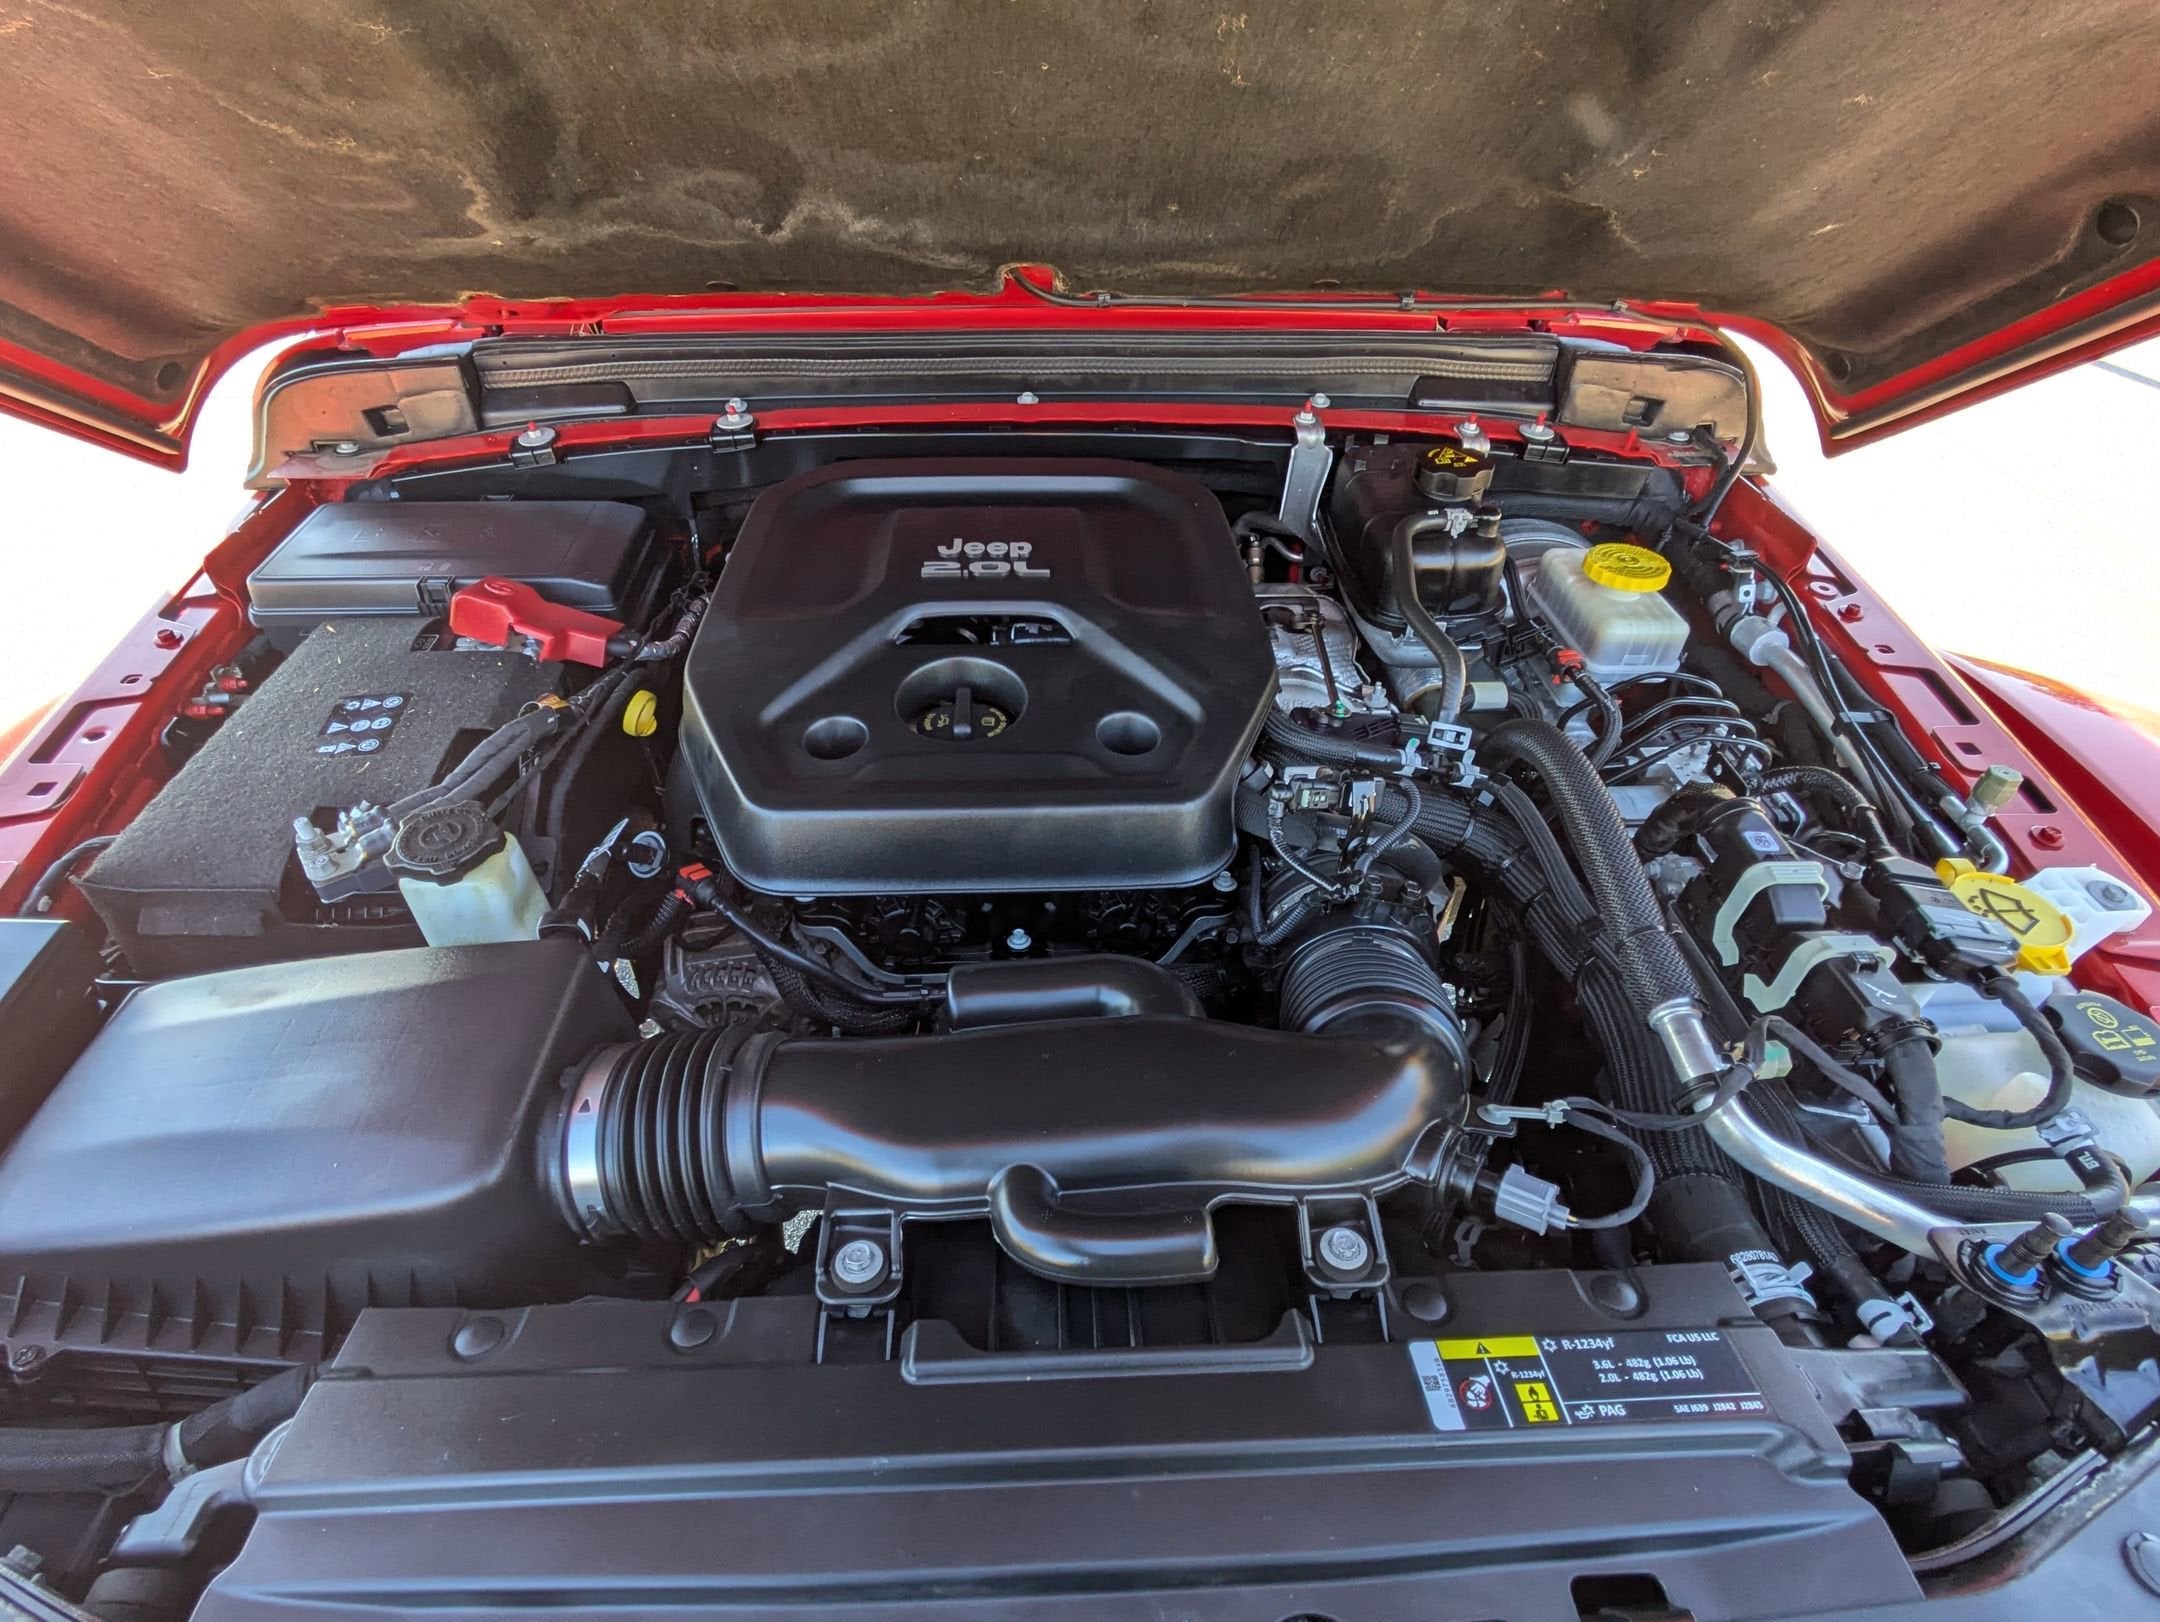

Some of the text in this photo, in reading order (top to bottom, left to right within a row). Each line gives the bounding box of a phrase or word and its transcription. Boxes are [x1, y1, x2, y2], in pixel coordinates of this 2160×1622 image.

[937, 538, 1033, 559] Jeep
[921, 560, 1050, 579] 2.0L
[1560, 1336, 1616, 1351] R-1234yf
[1666, 1331, 1720, 1344] FCA US LLC
[1592, 1358, 1616, 1371] 3.6L
[1626, 1356, 1652, 1369] 482g
[1652, 1356, 1679, 1368] (1.06
[1678, 1354, 1697, 1367] Lb)
[1510, 1370, 1546, 1380] R-1234yf
[1598, 1372, 1622, 1384] 2.0L
[1632, 1370, 1659, 1383] 482g
[1659, 1369, 1687, 1382] (1.06
[1686, 1368, 1705, 1380] Lb)
[1598, 1404, 1627, 1417] PAG
[1673, 1404, 1691, 1414] SAE
